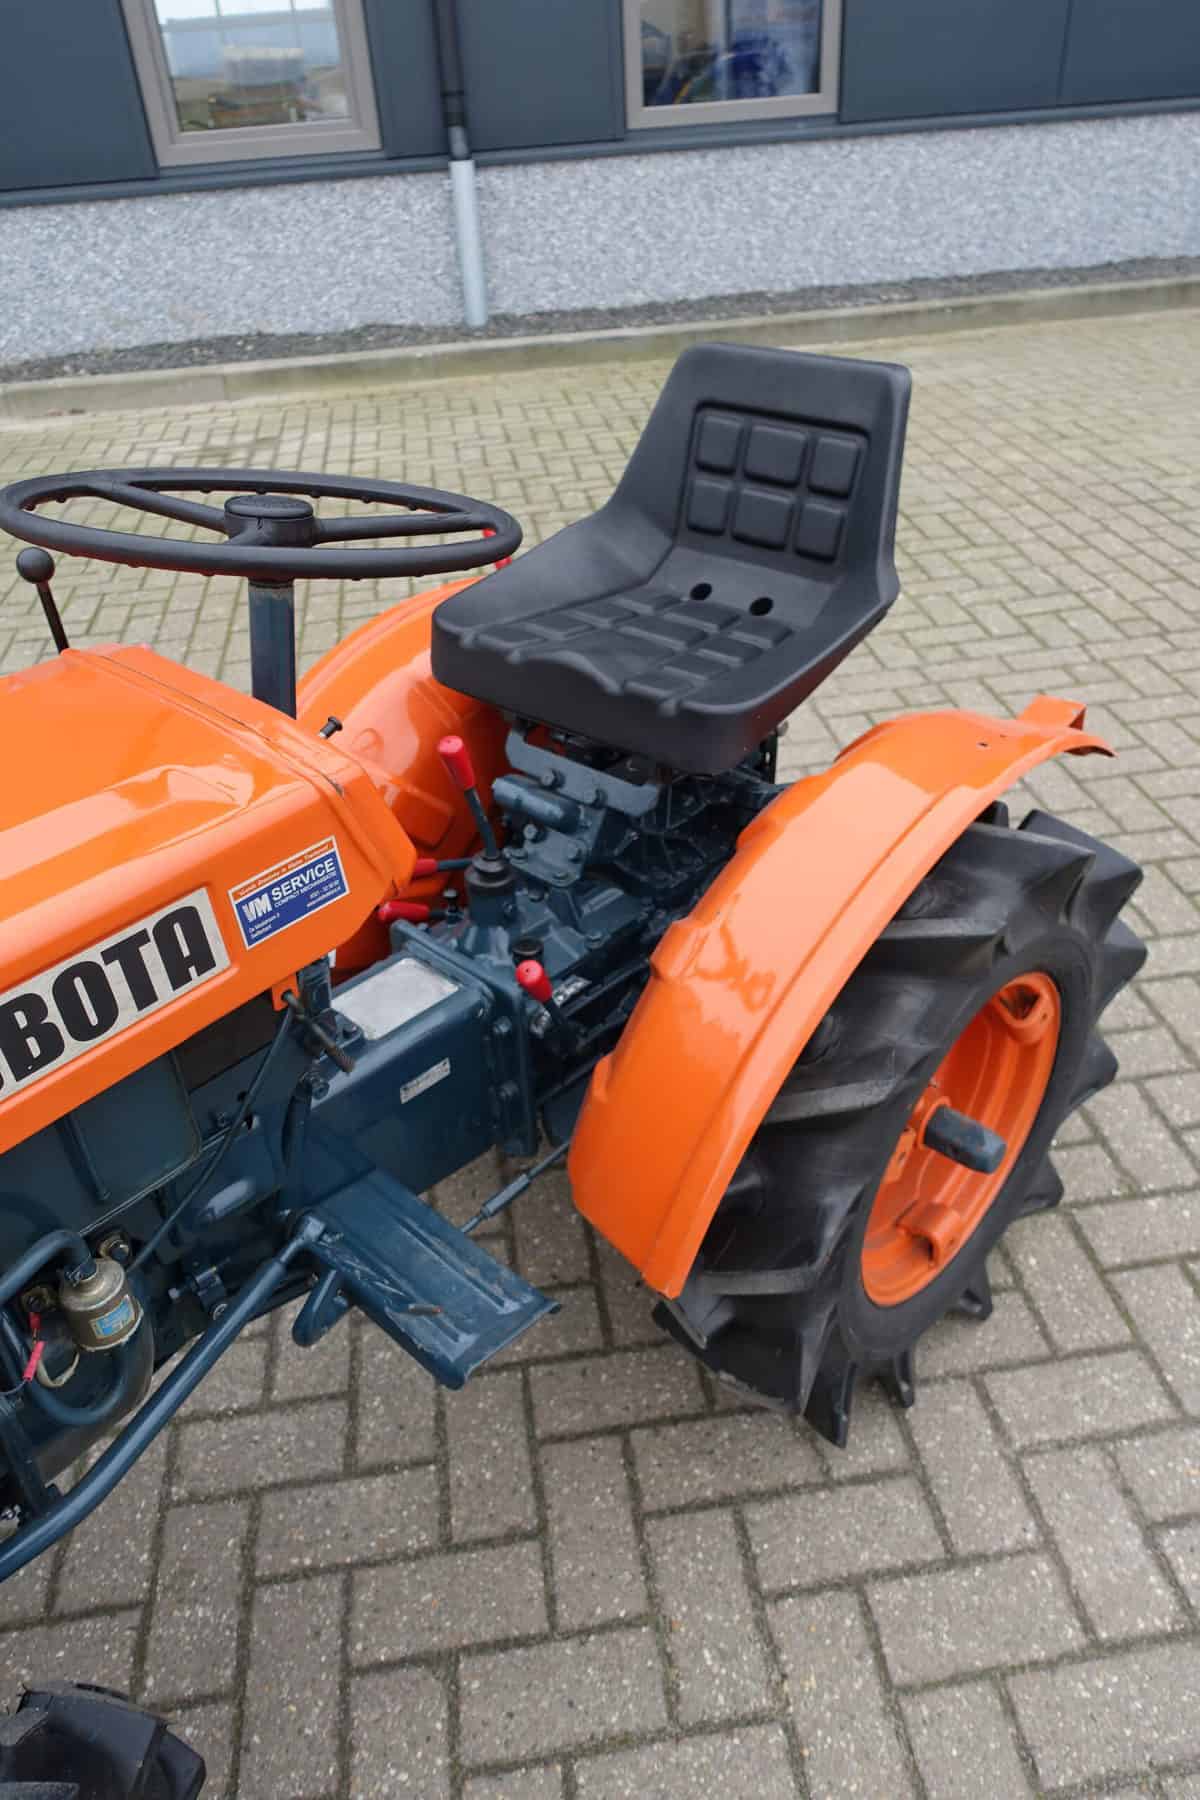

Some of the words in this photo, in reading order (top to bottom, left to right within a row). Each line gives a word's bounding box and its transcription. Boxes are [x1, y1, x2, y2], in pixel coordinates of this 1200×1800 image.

[242, 893, 272, 922] VM
[271, 858, 336, 901] SERVICE
[0, 906, 217, 1091] BOTA
